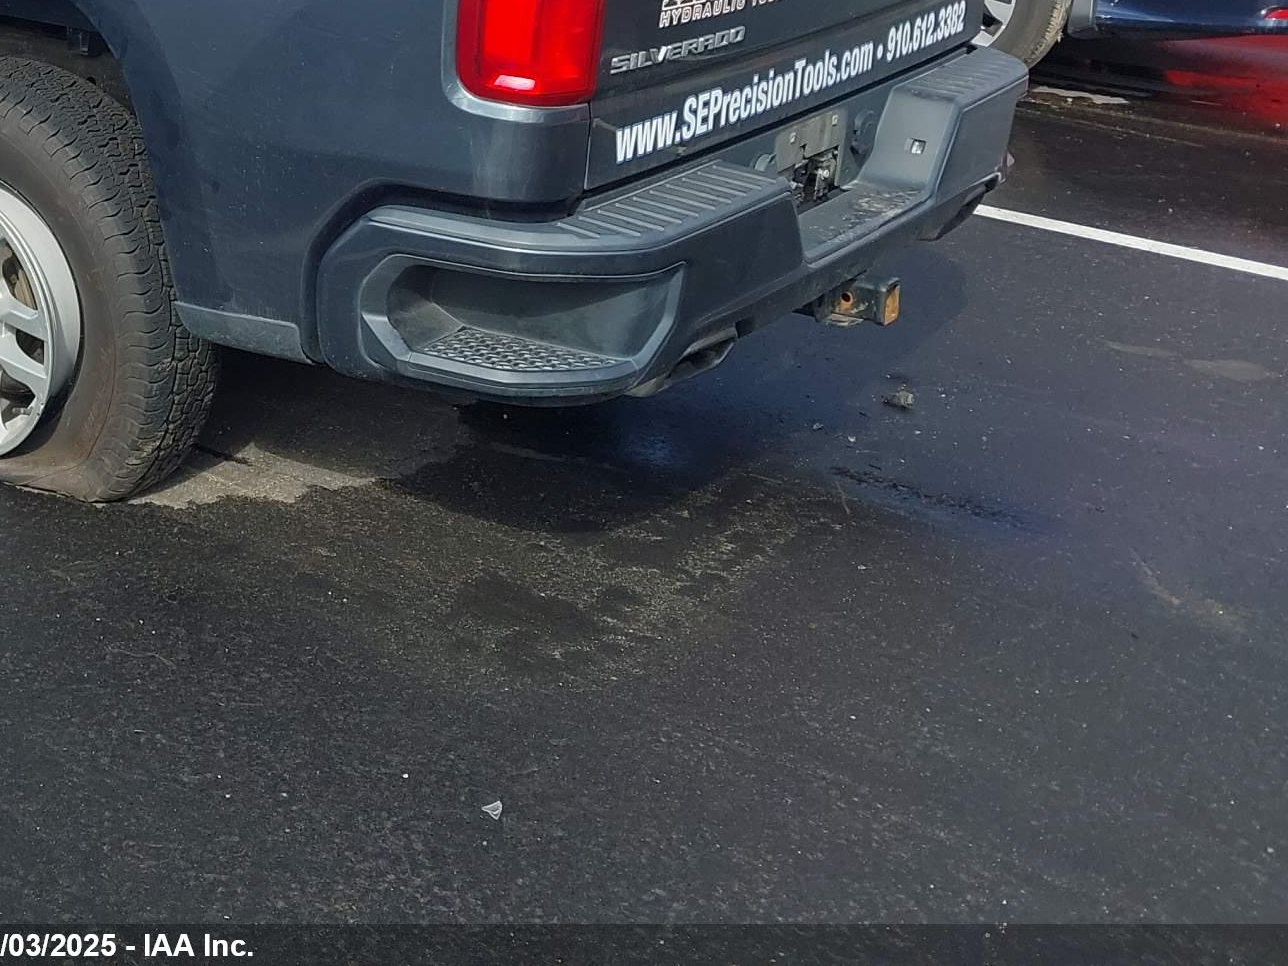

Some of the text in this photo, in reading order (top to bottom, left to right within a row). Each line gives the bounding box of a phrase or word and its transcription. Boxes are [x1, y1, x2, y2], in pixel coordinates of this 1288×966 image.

[609, 25, 746, 75] SILVERADO
[614, 0, 968, 164] www.SEPrecisionTools.com 910.612.3382
